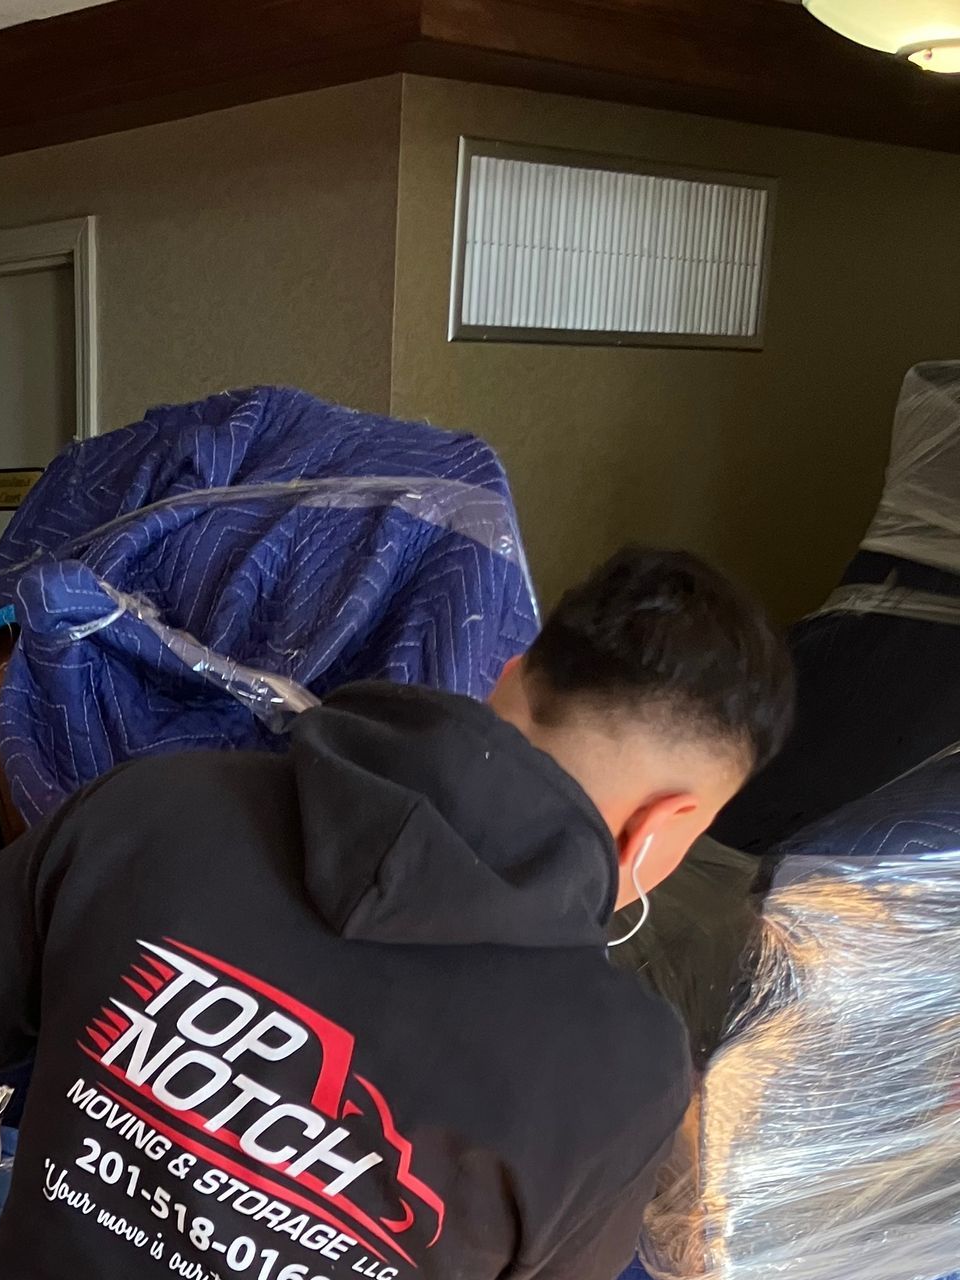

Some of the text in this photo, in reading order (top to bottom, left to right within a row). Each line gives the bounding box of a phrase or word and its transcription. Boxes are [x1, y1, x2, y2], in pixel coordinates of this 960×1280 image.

[136, 938, 309, 1063] TOP
[66, 1078, 172, 1163] MOVING
[168, 1152, 196, 1181] &
[193, 1168, 358, 1261] STORAGE
[100, 996, 383, 1197] NOTCH
[96, 1207, 149, 1248] move
[151, 1233, 165, 1261] is
